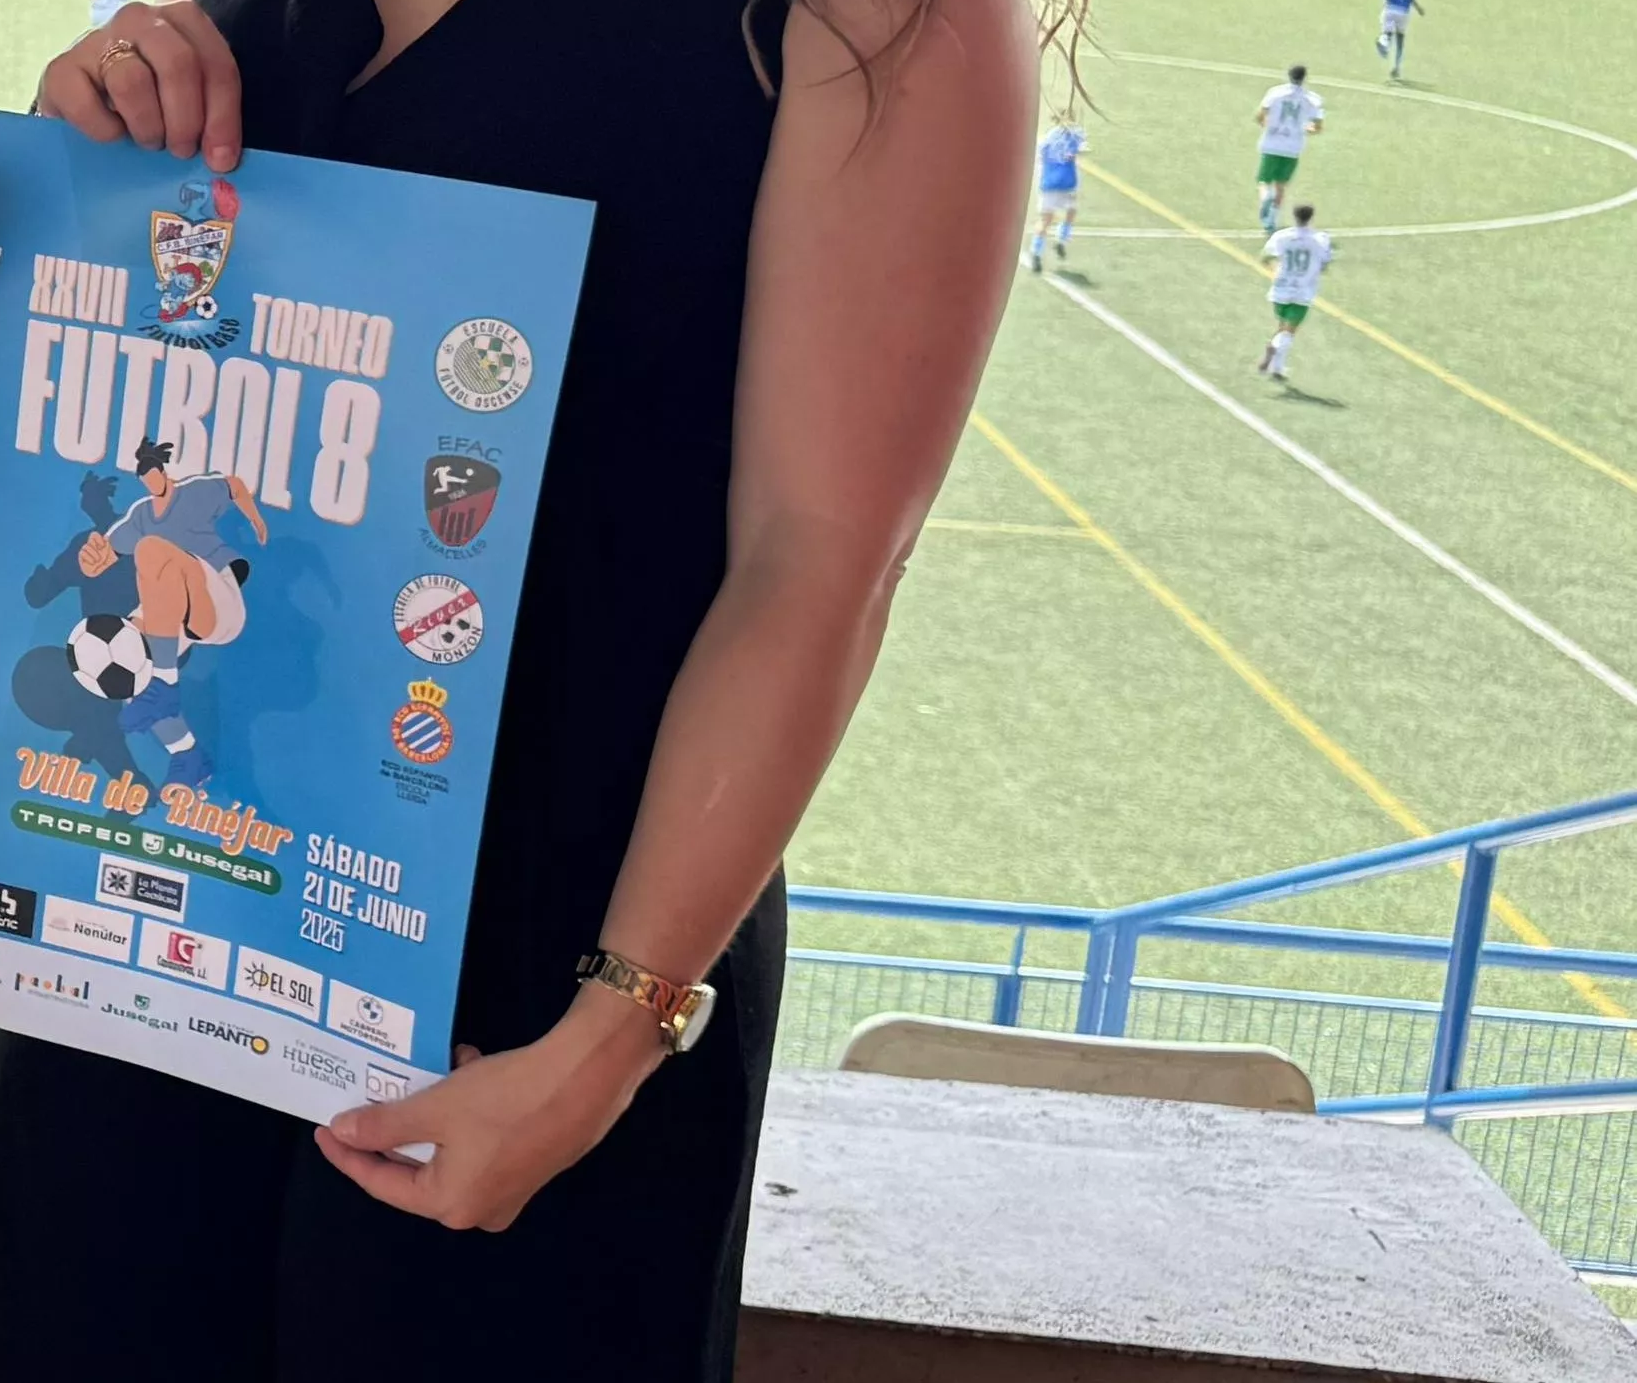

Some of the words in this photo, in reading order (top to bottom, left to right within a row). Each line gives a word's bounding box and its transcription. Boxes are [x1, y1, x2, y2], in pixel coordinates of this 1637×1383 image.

[29, 253, 129, 328] XXVII
[250, 292, 394, 380] TORNEO
[463, 321, 518, 346] ESCUELA
[15, 318, 303, 511] FUTBOL
[310, 378, 382, 526] 8
[437, 434, 503, 464] EFAC
[418, 527, 488, 561] ALMACELLES
[16, 746, 98, 804] Villa
[102, 770, 150, 816] de
[160, 781, 294, 857] Binéfar
[18, 808, 132, 846] TROFEO
[168, 842, 274, 887] Jusegal
[306, 830, 402, 894] SÁBADO
[303, 870, 325, 906] 21
[327, 878, 357, 917] DE
[357, 893, 428, 944] JUNIO
[73, 922, 129, 947] Nenúfar
[299, 908, 348, 953] 2025
[270, 972, 284, 996] EL
[289, 979, 315, 1007] SOL
[101, 1002, 179, 1033] Jusegal
[189, 1017, 269, 1055] LEPANTO
